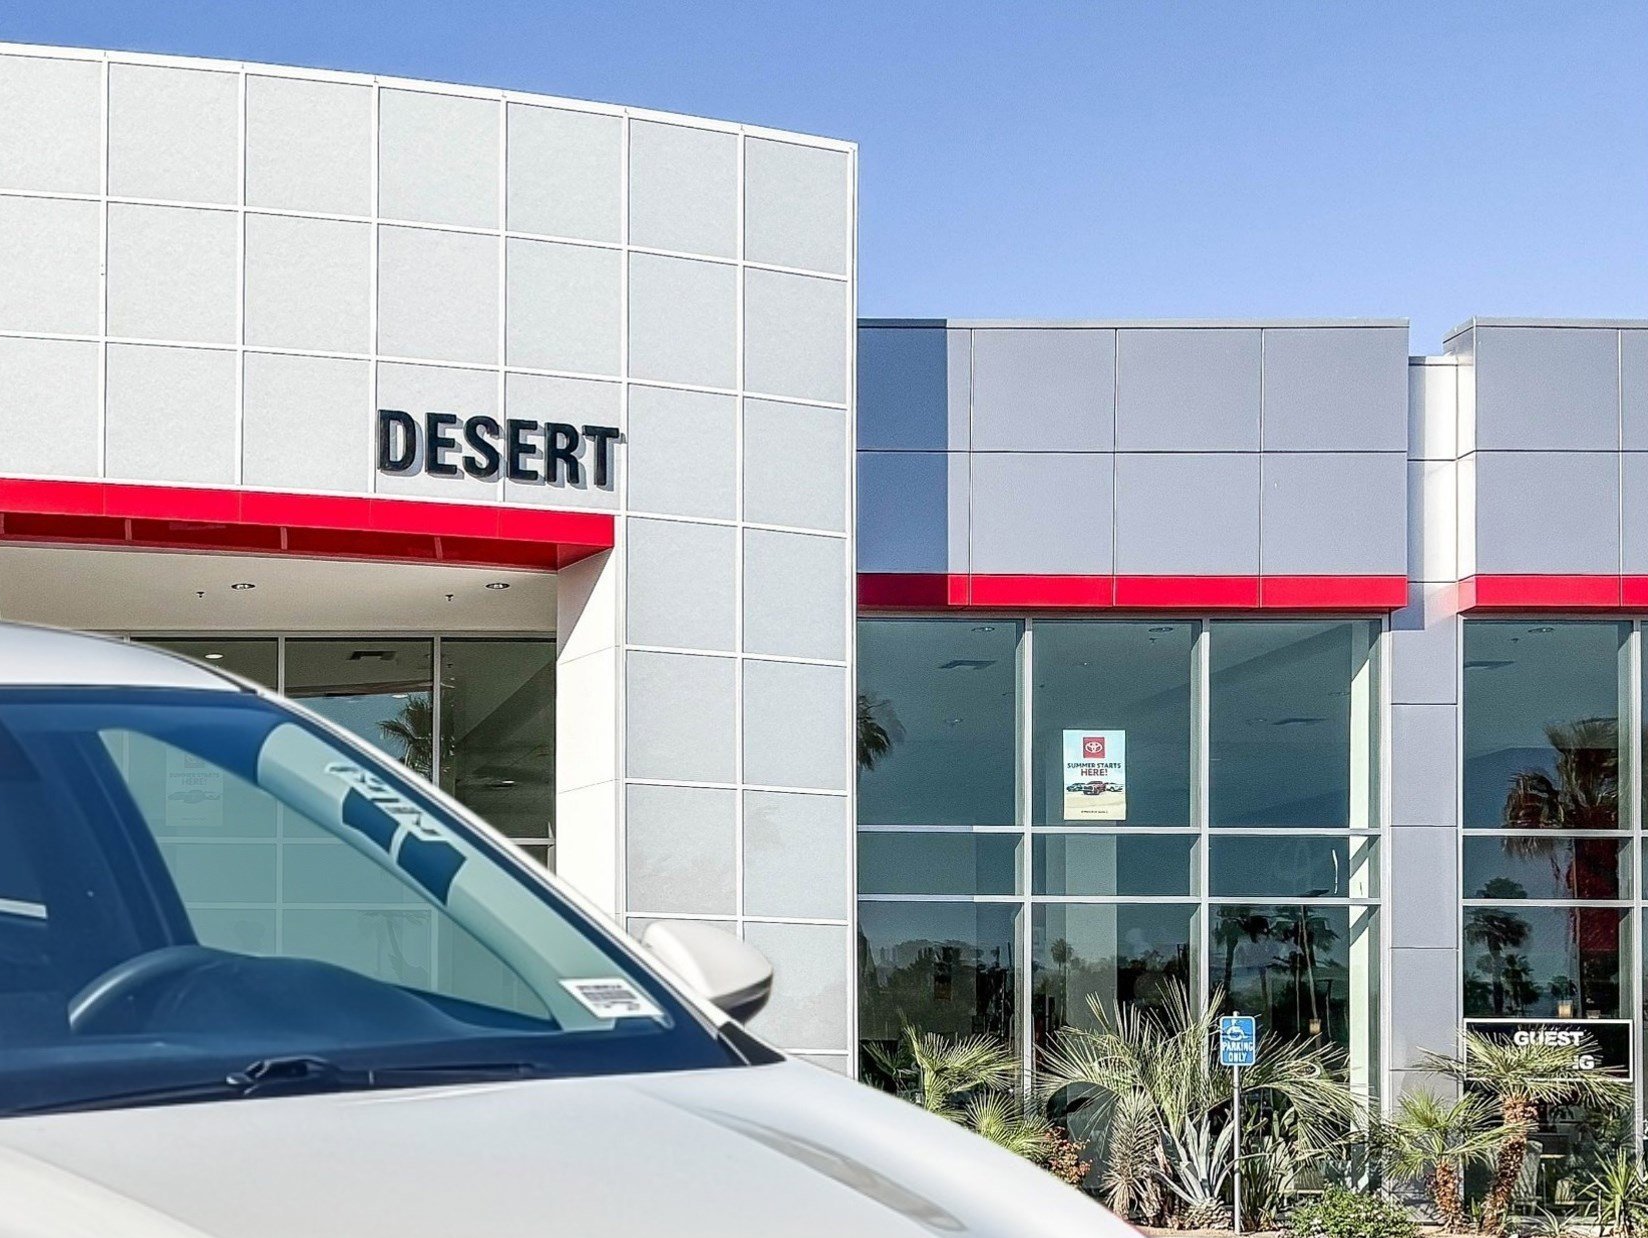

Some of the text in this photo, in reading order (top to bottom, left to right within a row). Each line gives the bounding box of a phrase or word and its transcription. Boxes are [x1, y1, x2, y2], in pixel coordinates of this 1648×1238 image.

[377, 409, 620, 487] DESERT
[1080, 768, 1108, 776] HERE!
[1513, 1030, 1584, 1046] GUEST
[1222, 1041, 1254, 1052] PARKING
[1228, 1052, 1247, 1062] ONLY
